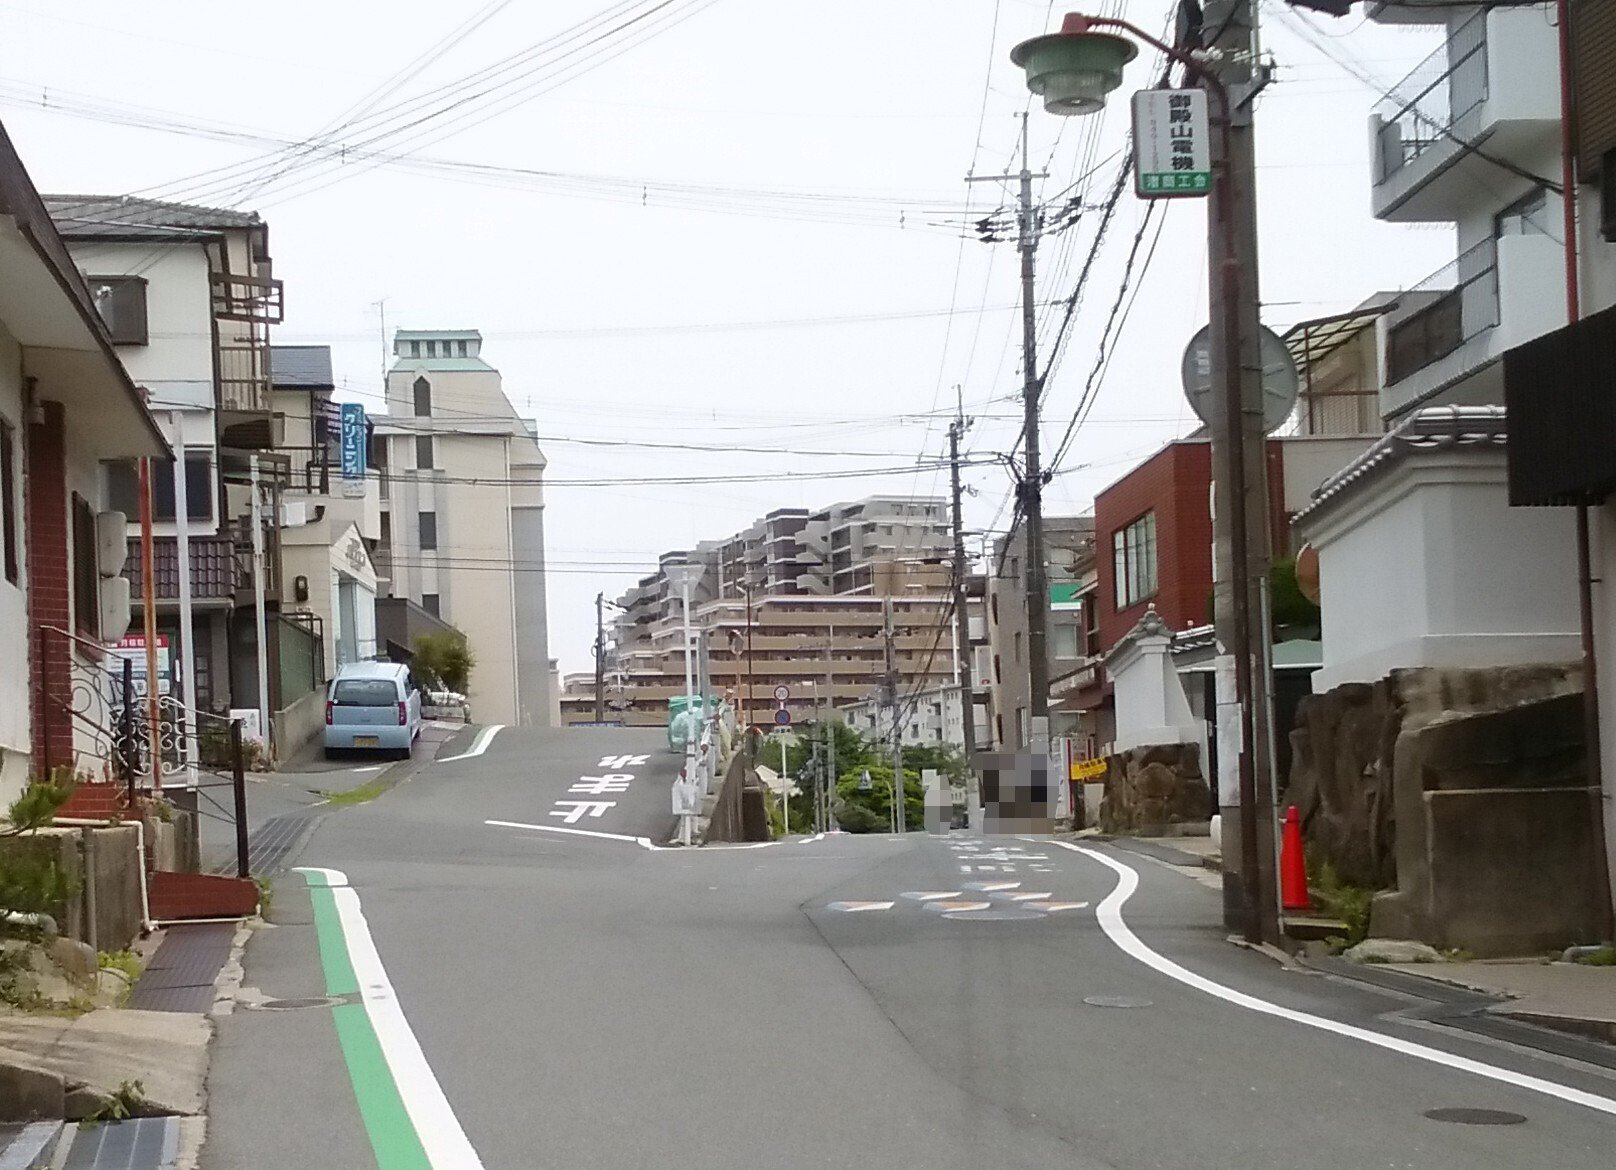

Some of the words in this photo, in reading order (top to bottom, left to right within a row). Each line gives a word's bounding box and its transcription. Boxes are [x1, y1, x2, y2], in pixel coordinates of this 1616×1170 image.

[343, 413, 358, 477] クリーニング
[549, 754, 651, 823] 止まれ
